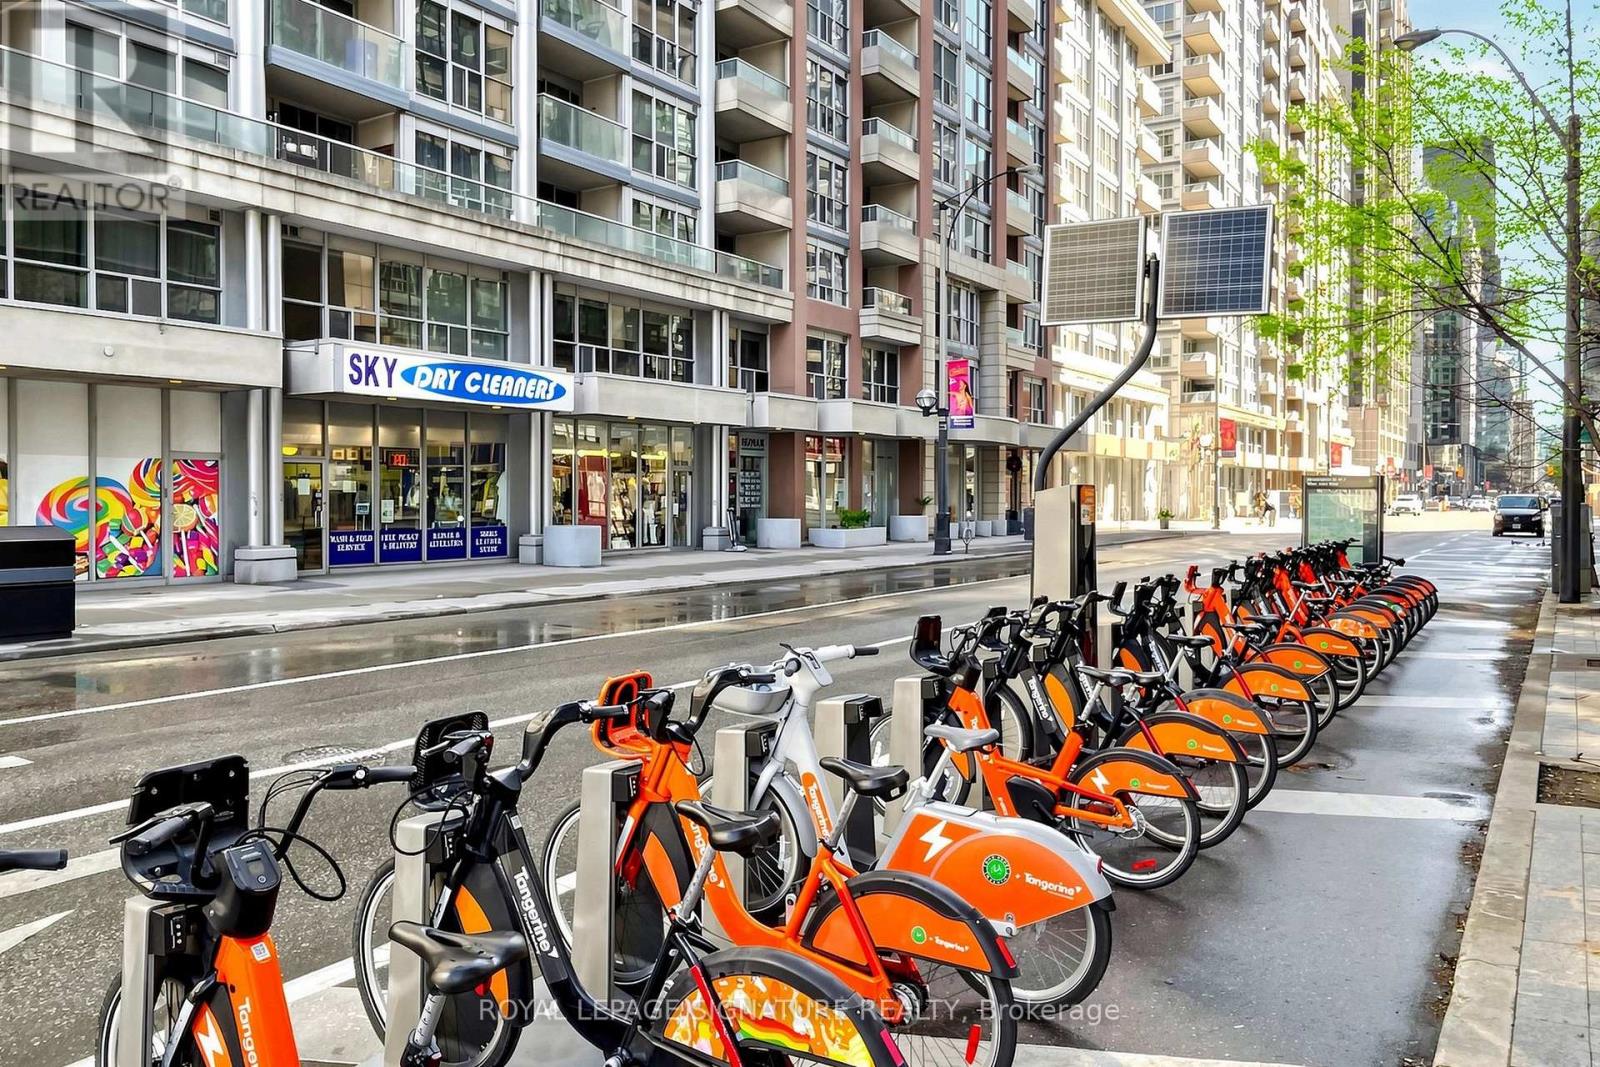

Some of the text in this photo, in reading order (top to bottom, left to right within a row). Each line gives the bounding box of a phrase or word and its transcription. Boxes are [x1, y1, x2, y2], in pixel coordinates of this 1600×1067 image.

[349, 353, 559, 400] SKY DRY CLEANERS
[513, 866, 550, 952] Tangerine
[1024, 872, 1075, 896] Tangerine
[238, 997, 258, 1067] Tange
